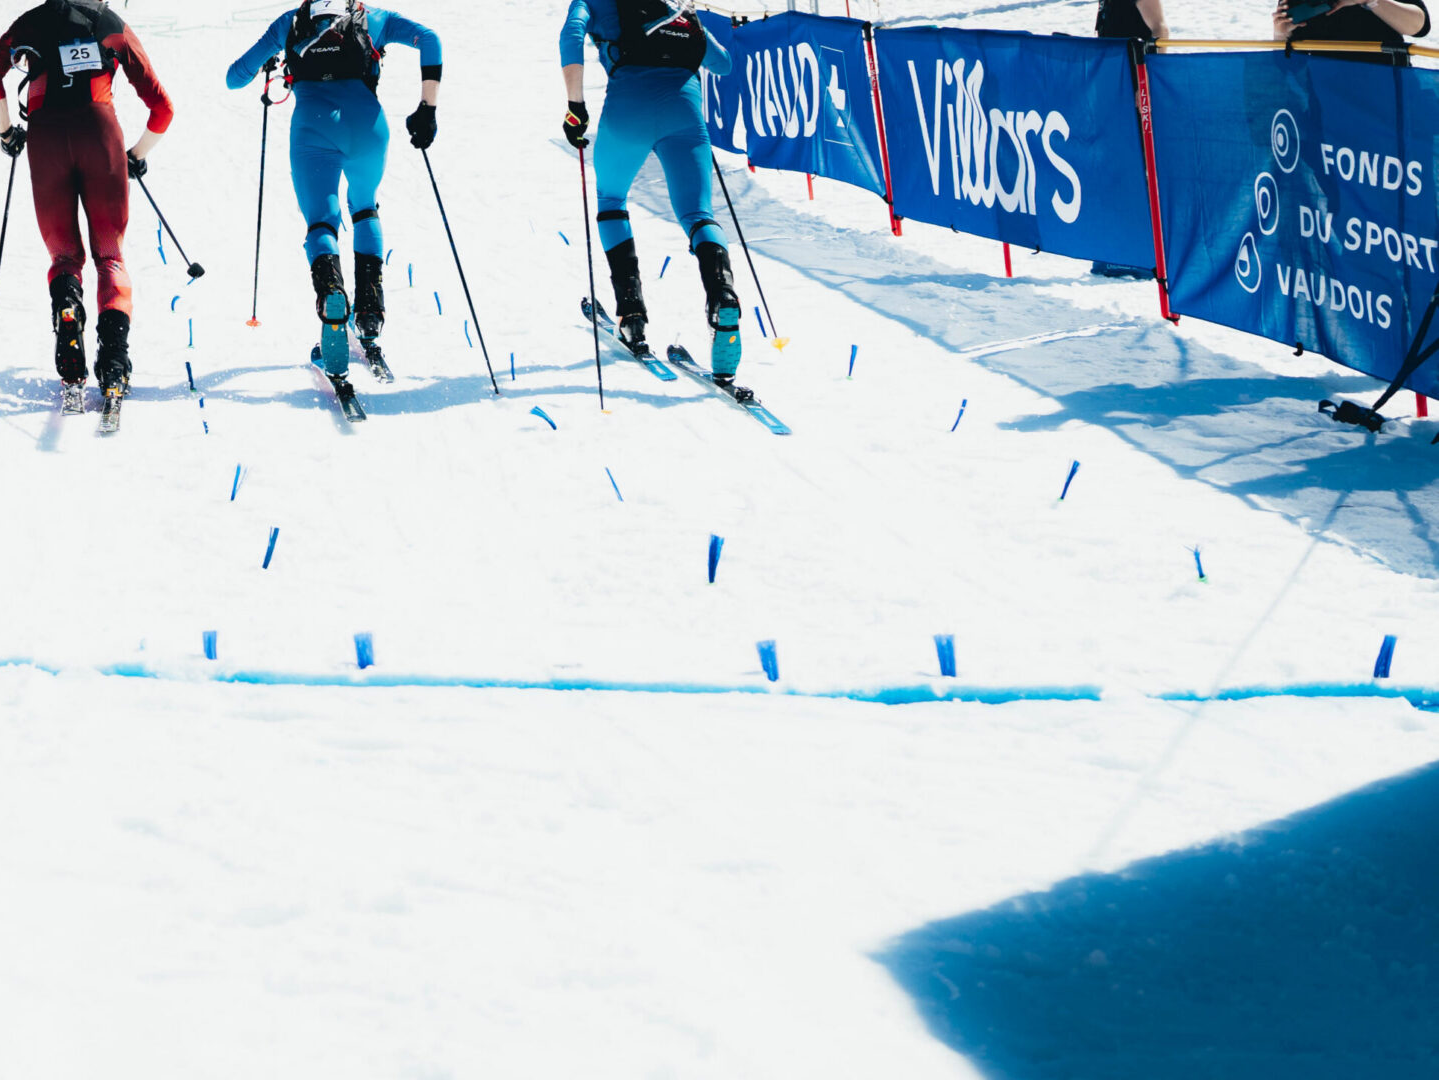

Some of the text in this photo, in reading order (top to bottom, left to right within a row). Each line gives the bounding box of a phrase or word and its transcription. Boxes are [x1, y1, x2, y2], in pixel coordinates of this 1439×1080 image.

[323, 0, 332, 8] 7
[69, 47, 90, 61] 25
[746, 42, 820, 139] VAUD
[1140, 88, 1150, 131] LISKI
[907, 57, 1082, 224] Villars
[1320, 142, 1423, 197] FONDS
[1299, 205, 1439, 274] DU SPORT
[1276, 263, 1393, 330] VAUDOIS
